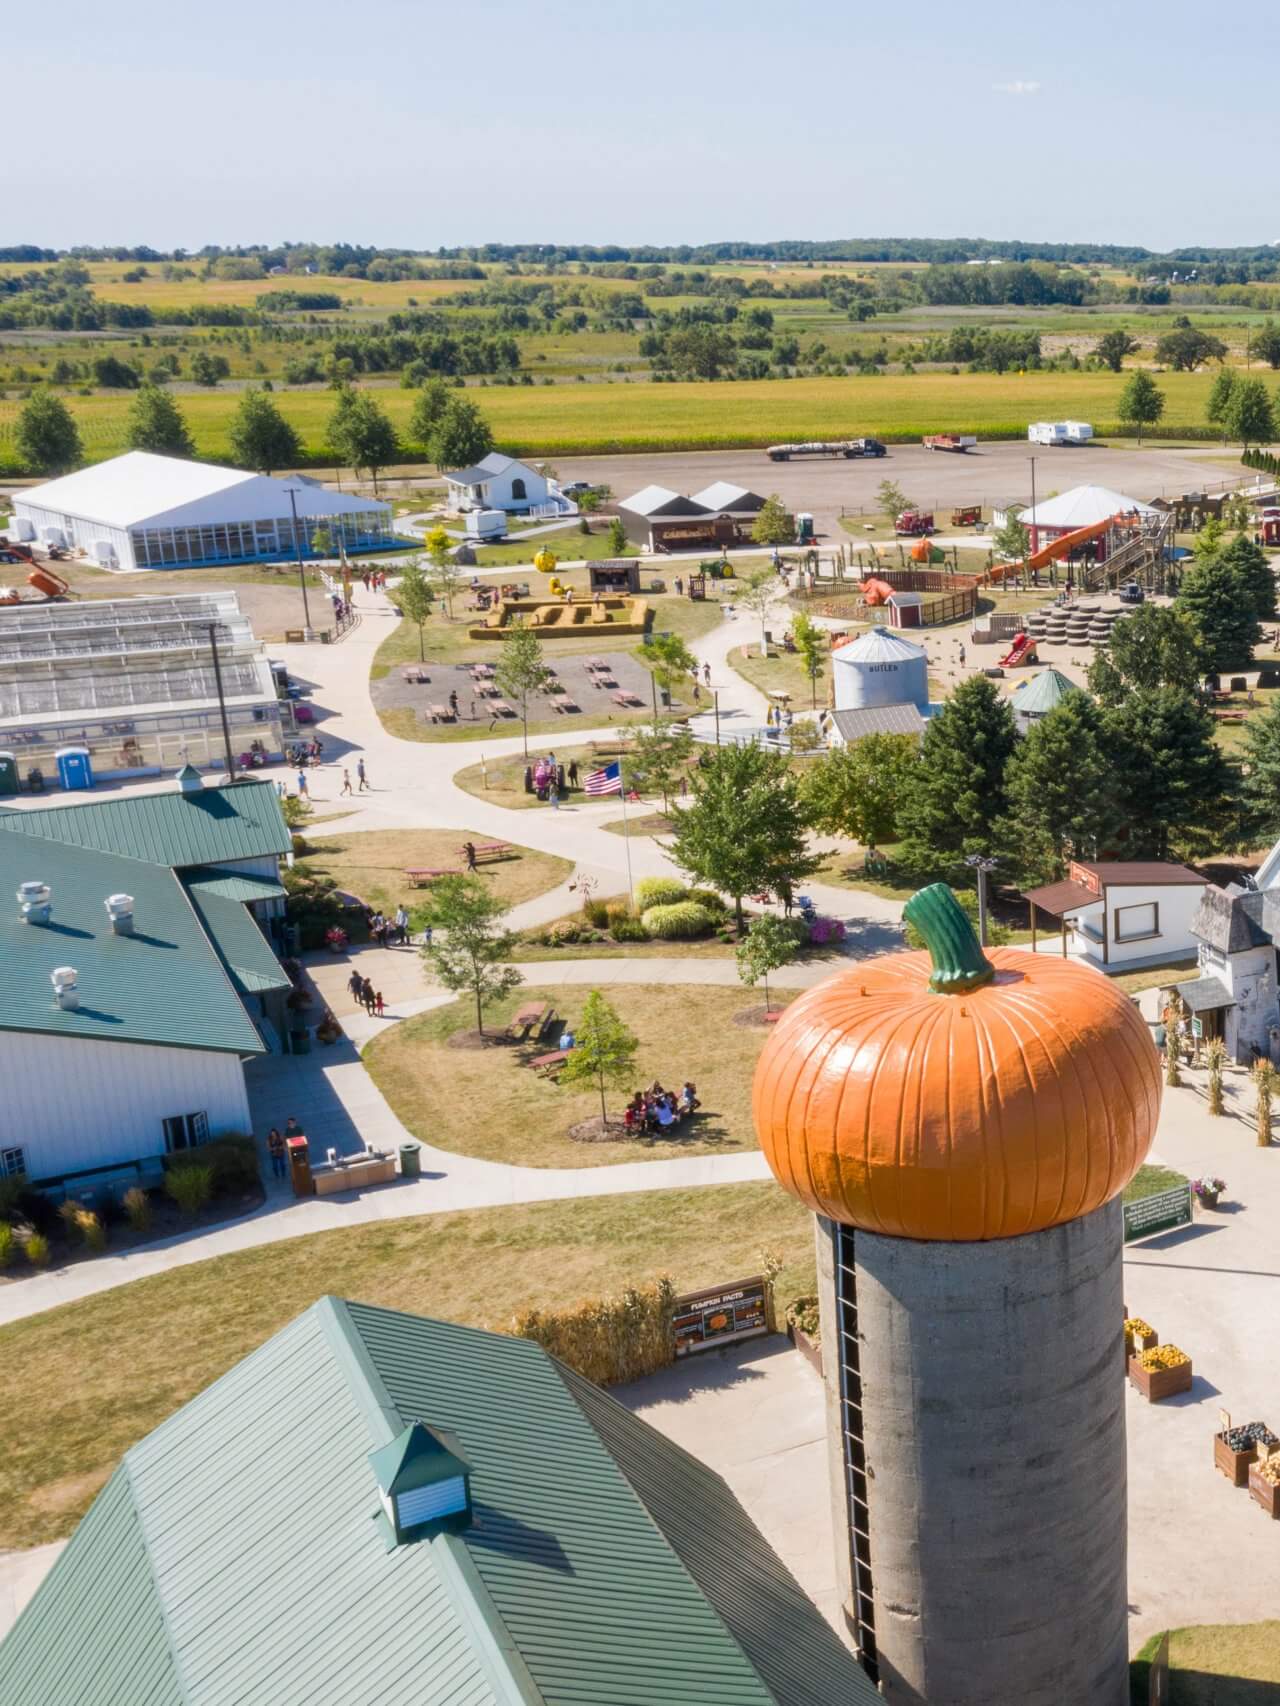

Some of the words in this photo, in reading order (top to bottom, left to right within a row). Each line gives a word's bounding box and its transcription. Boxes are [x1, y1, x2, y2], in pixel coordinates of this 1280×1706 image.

[869, 664, 898, 672] BUTLER
[691, 1298, 721, 1311] PUMPKIN
[722, 1291, 743, 1302] FACTS
